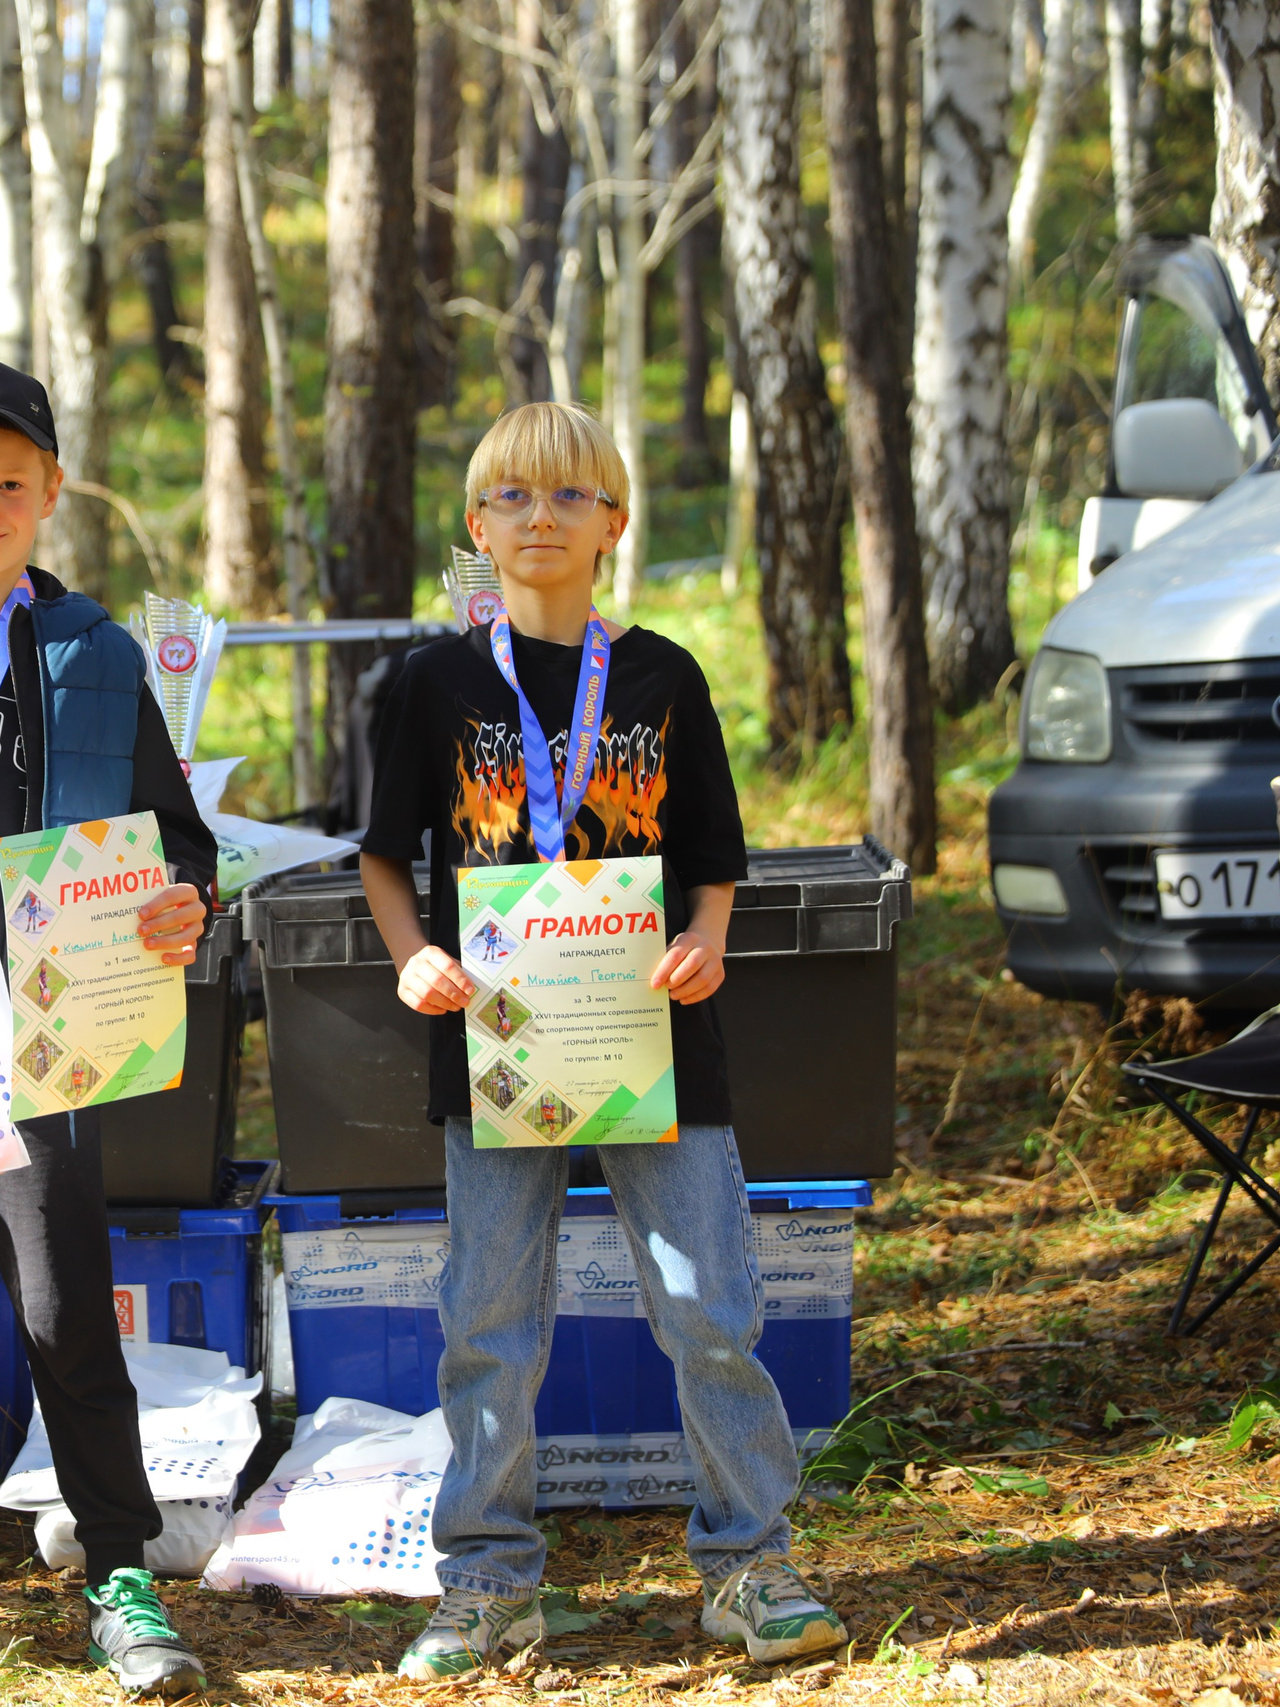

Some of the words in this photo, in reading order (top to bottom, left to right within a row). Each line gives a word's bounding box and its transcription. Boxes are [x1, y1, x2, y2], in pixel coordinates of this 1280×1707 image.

[570, 731, 592, 791] ГОРНЫЙ
[581, 674, 600, 727] КОРОЛЬ
[59, 866, 165, 906] ГРАМОТА
[524, 911, 658, 939] ГРАМОТА
[559, 947, 626, 958] НАГРАЖДАЕТСЯ
[114, 956, 119, 965] 1
[122, 955, 141, 963] место
[71, 979, 86, 987] XXVI
[86, 971, 132, 985] традиционных
[591, 968, 636, 982] Георгий
[81, 987, 122, 1000] спортивному
[123, 976, 175, 992] ориентированию
[94, 999, 125, 1011] «ГОРНЫЙ
[125, 994, 154, 1005] КОРОЛЬ»
[586, 995, 592, 1003] 3
[104, 1015, 128, 1026] группе:
[137, 1011, 145, 1019] 10
[534, 1012, 551, 1020] XXVI
[552, 1010, 607, 1020] традиционных
[608, 1007, 663, 1017] соревнованиях
[546, 1025, 594, 1034] спортивному
[595, 1021, 658, 1031] ориентированию
[562, 1036, 597, 1046] «ГОРНЫЙ
[599, 1036, 633, 1044] КОРОЛЬ»
[575, 1055, 601, 1063] группе:
[312, 1261, 378, 1276] NORD
[300, 1286, 365, 1300] NORD
[568, 1449, 673, 1463] NORD
[536, 1480, 608, 1494] ORD
